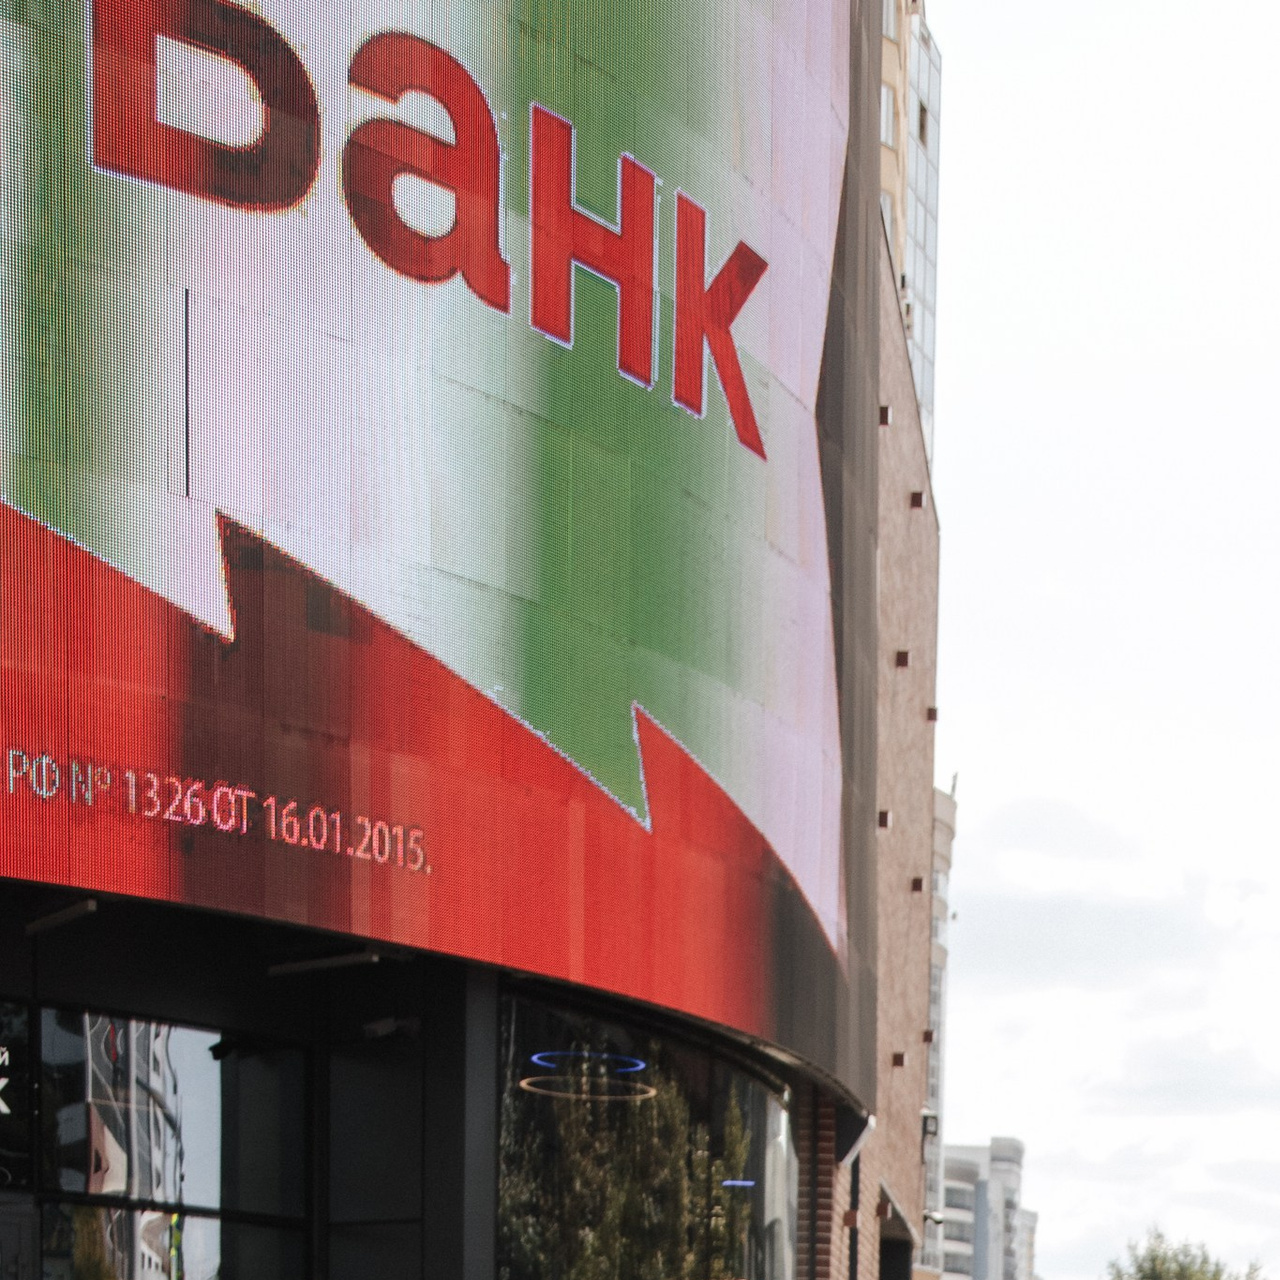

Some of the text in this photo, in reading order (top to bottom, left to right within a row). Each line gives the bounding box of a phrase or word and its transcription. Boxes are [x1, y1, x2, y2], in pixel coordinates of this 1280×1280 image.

[8, 749, 60, 799] РФ
[125, 769, 207, 826] 1326
[262, 795, 432, 875] 16.01.2015.
